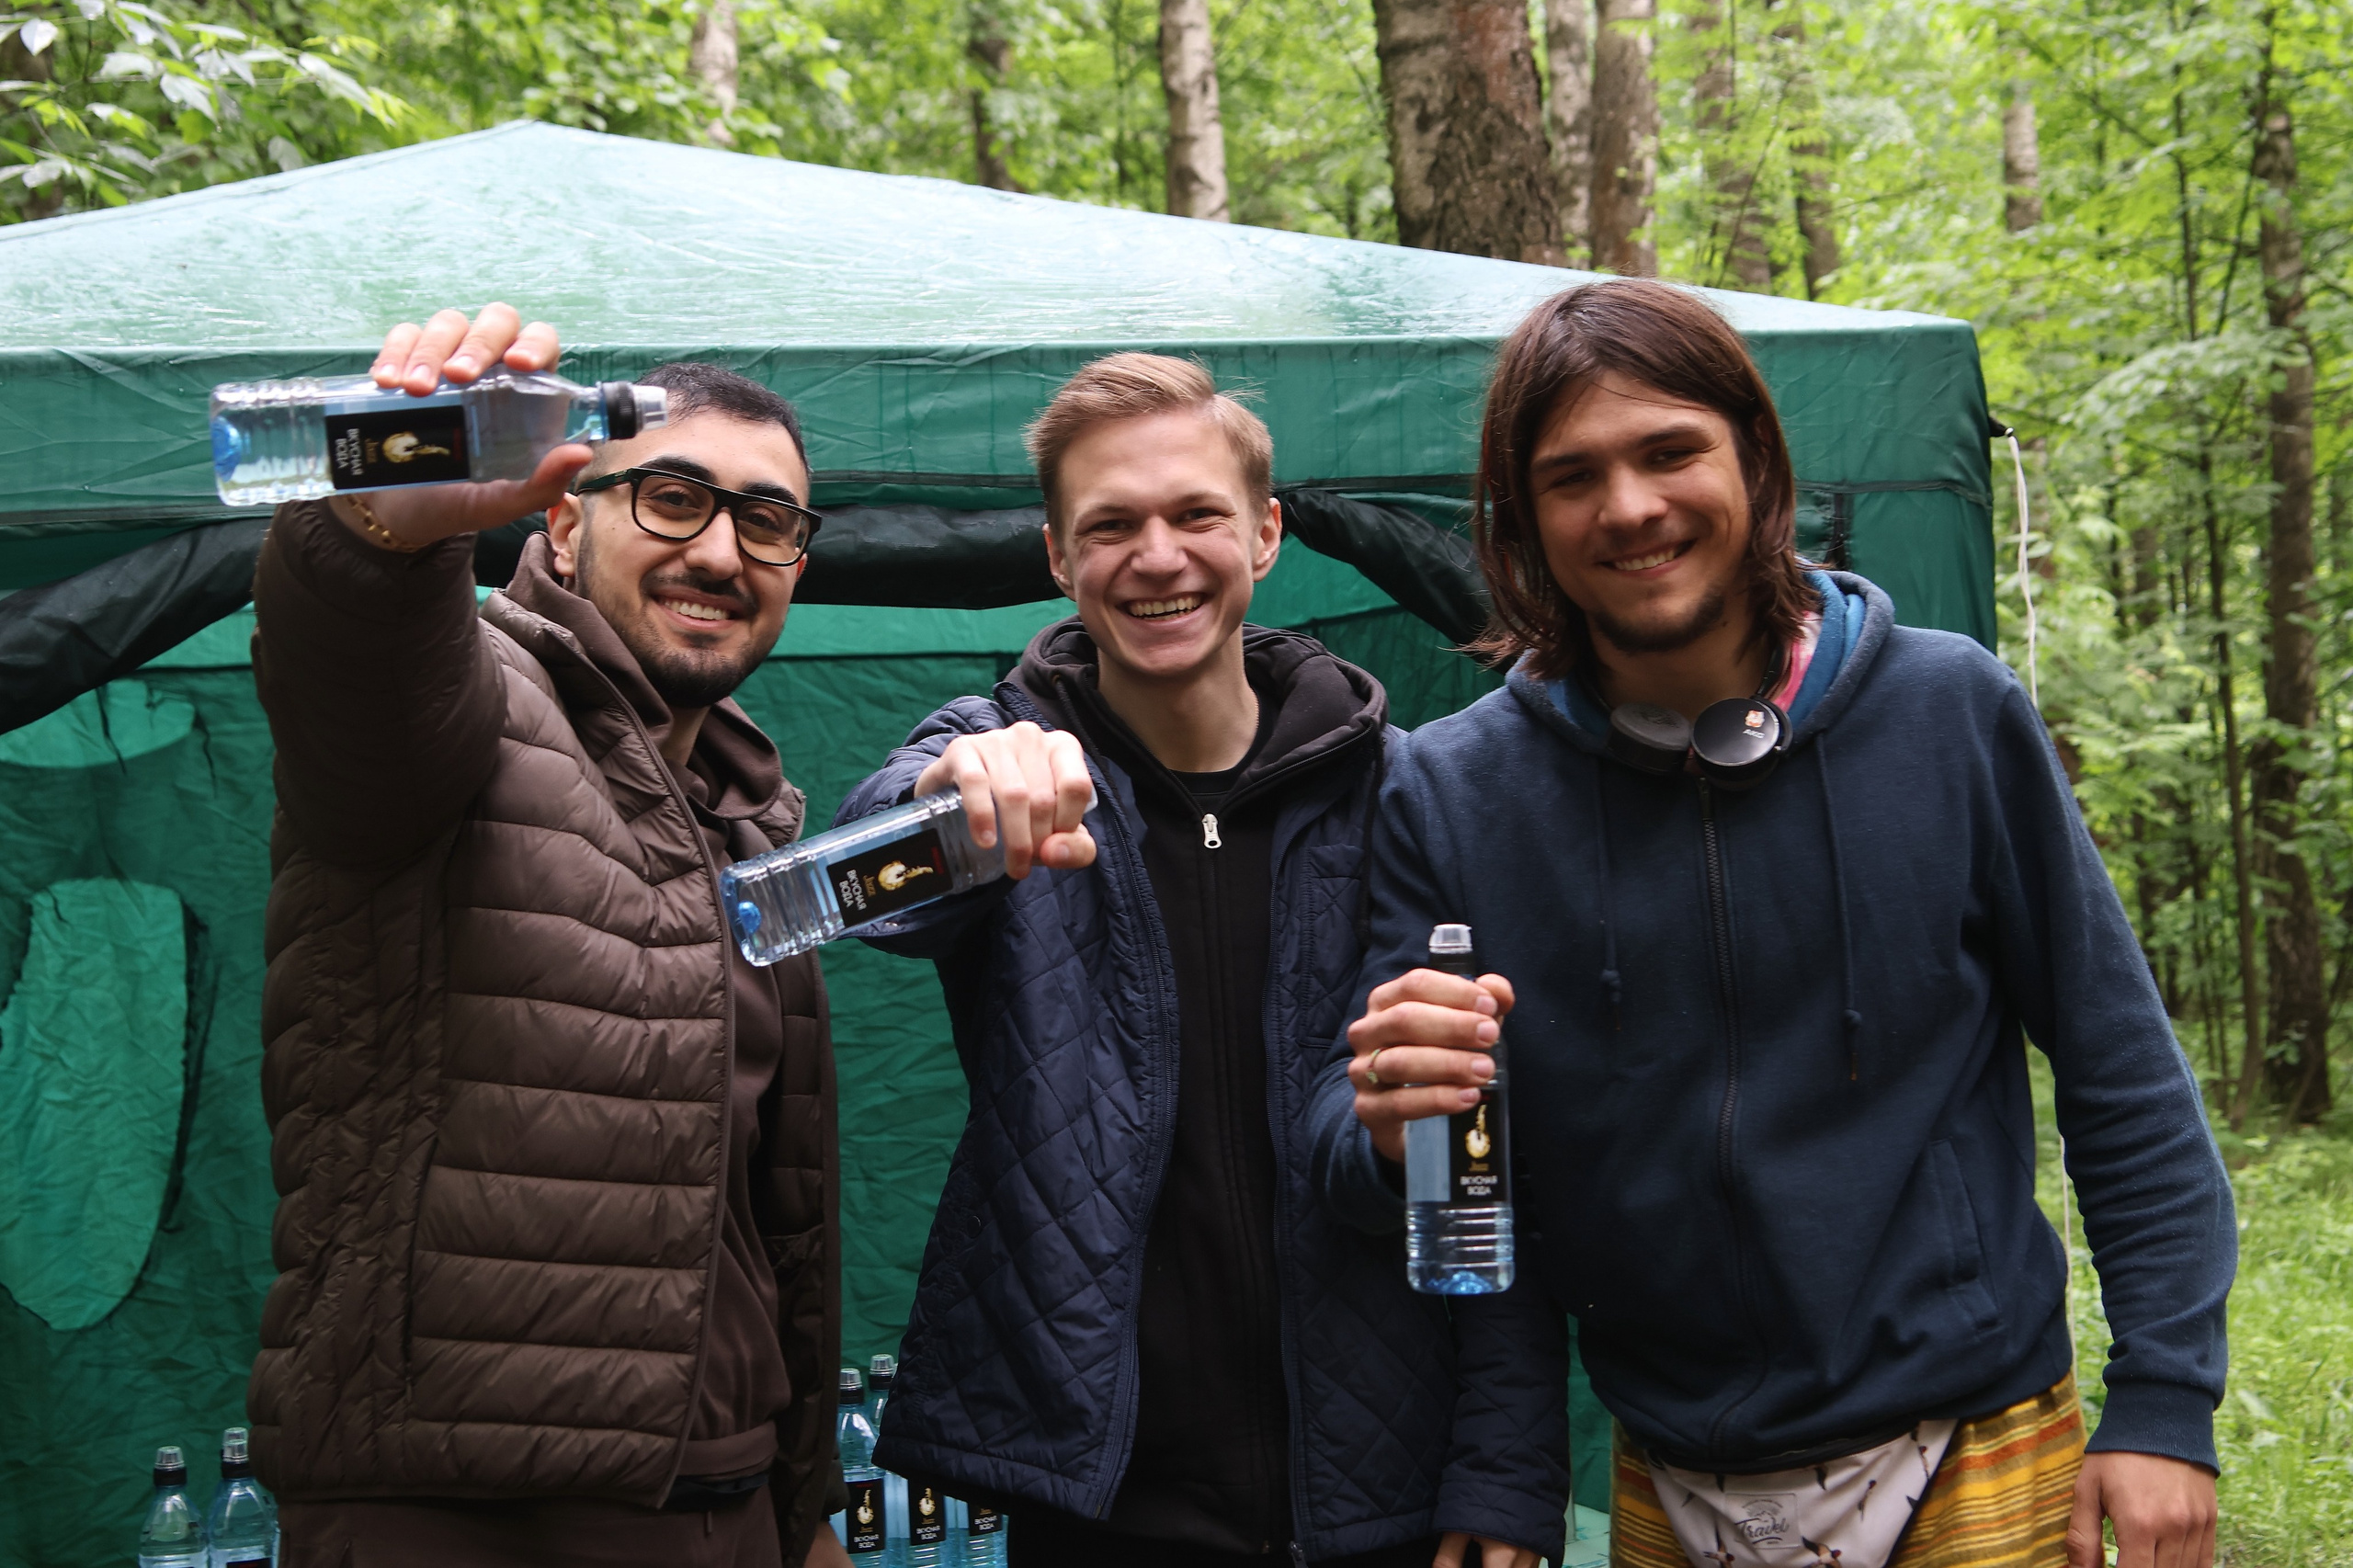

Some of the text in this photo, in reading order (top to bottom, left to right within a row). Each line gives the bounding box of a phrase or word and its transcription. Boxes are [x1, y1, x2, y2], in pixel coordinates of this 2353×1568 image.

[335, 438, 348, 469] ВОДА
[839, 881, 854, 907] ВОДА
[847, 869, 867, 910] ВКУСНАЯ
